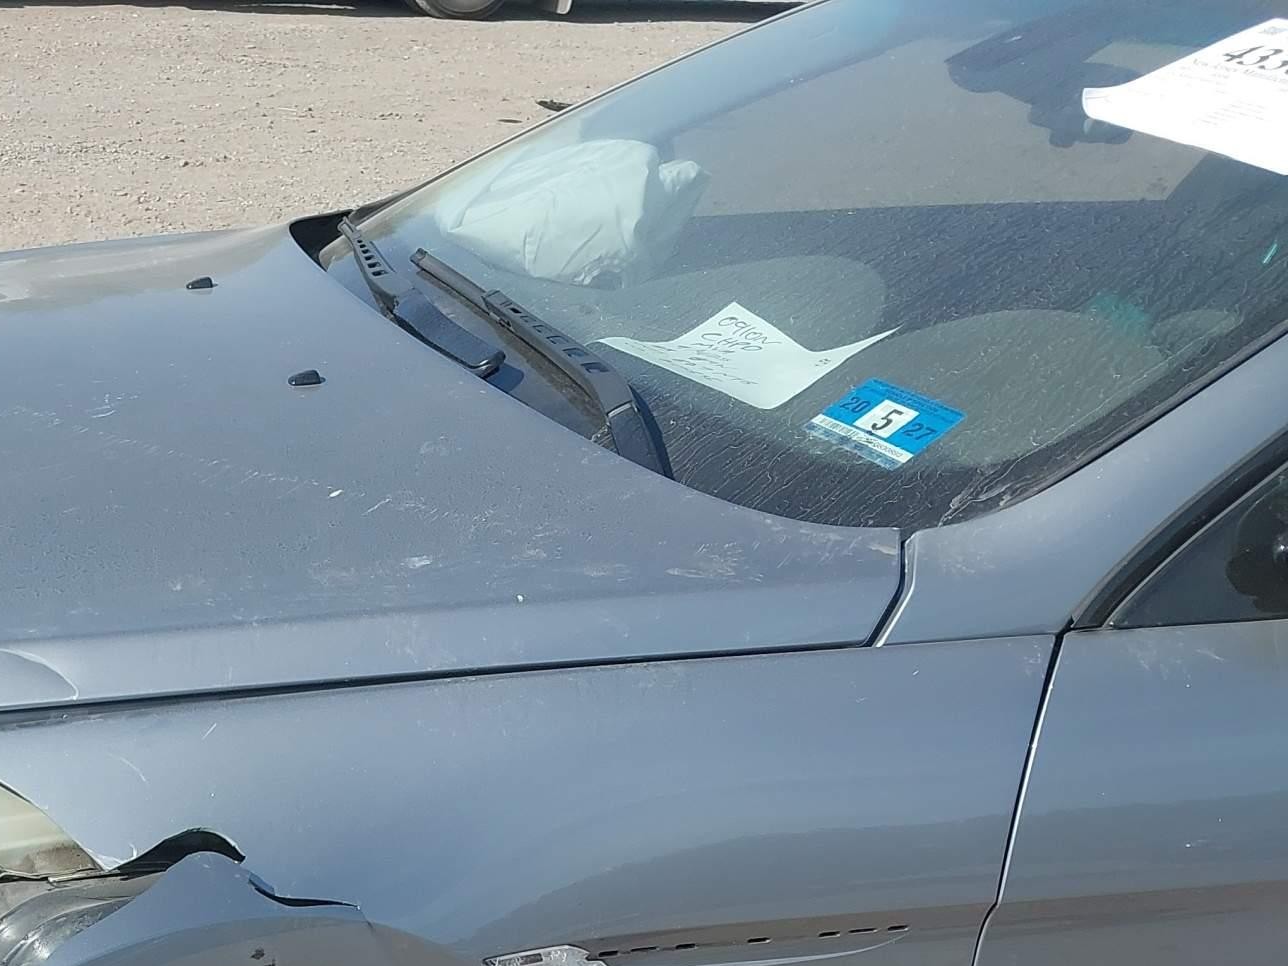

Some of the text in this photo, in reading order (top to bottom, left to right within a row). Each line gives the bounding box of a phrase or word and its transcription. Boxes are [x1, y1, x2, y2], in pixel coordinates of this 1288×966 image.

[840, 396, 871, 413] 20
[872, 409, 904, 430] 5
[902, 422, 936, 440] 27
